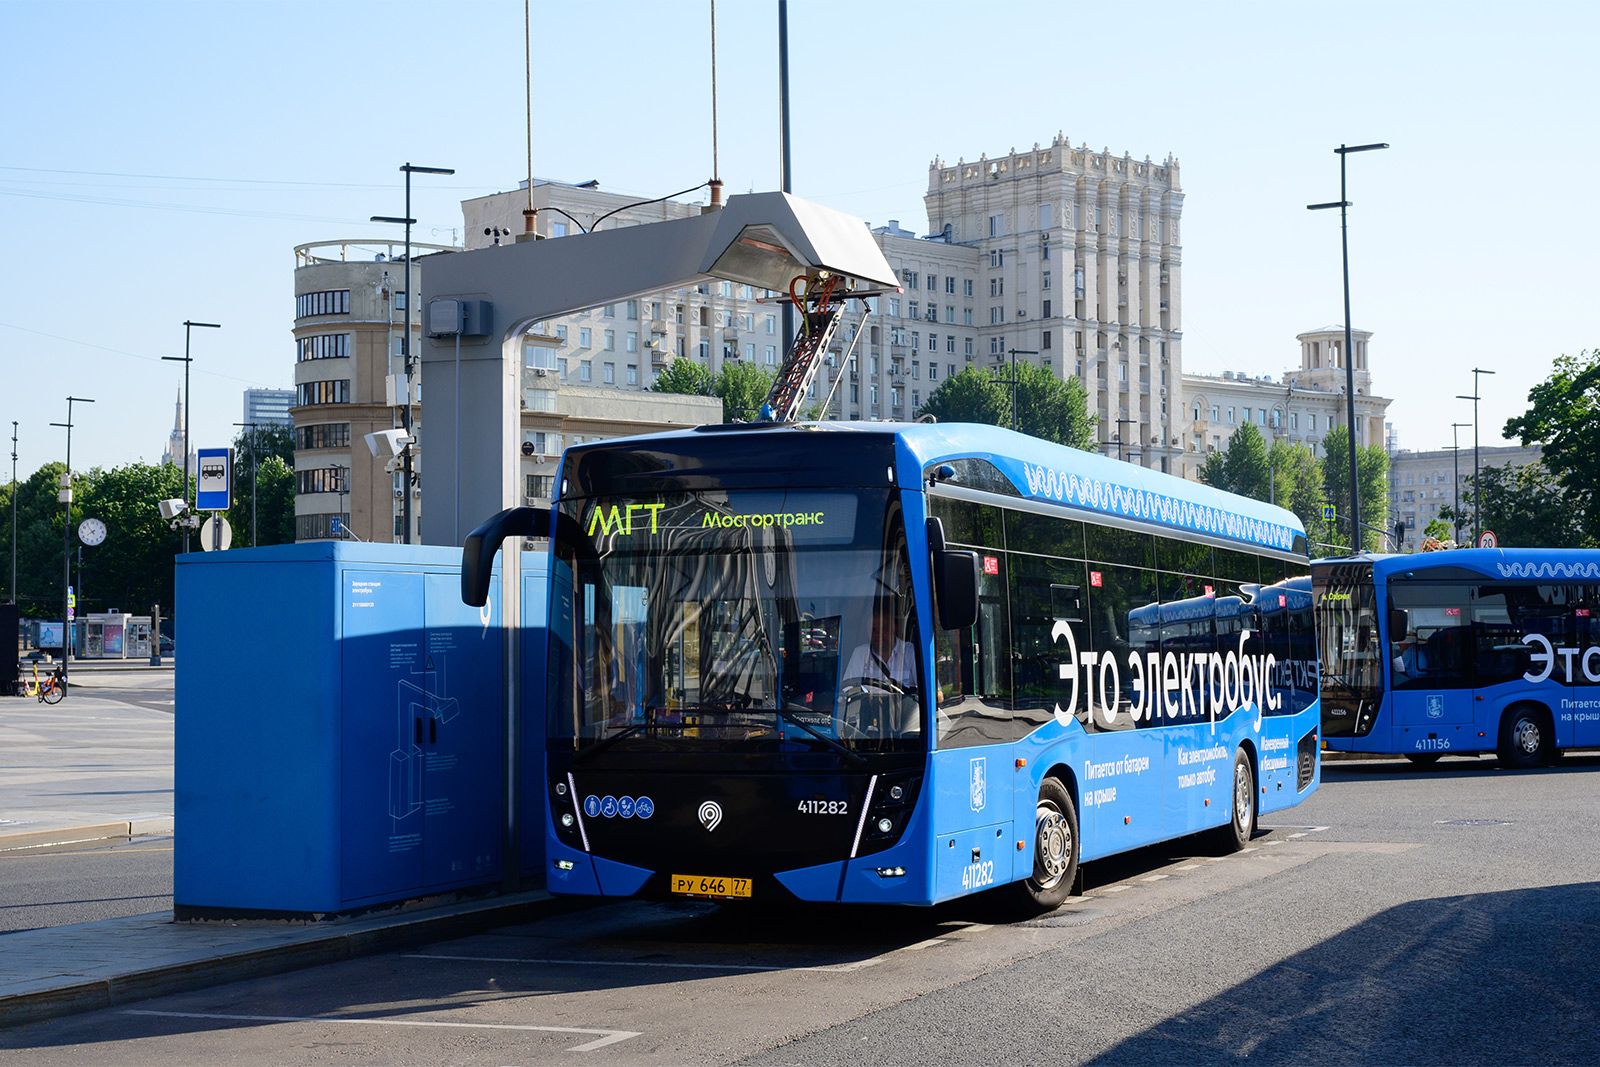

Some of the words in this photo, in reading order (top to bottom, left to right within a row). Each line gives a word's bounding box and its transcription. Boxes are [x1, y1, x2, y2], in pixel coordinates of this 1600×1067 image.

[588, 503, 665, 536] МГТ
[702, 511, 824, 532] Мосгортранс
[1482, 538, 1493, 548] 20
[1521, 633, 1600, 683] Это
[1051, 619, 1120, 727] Это
[1561, 698, 1600, 709] Питаетс
[1561, 713, 1572, 721] на
[1574, 713, 1600, 723] крыш
[1415, 739, 1450, 749] 411156
[1178, 747, 1188, 765] Как
[1084, 760, 1115, 781] Питается
[1116, 760, 1123, 776] от
[1124, 754, 1150, 776] батареи
[1197, 765, 1215, 787] автобус
[797, 800, 848, 815] 411282
[1084, 791, 1093, 807] на
[1094, 787, 1116, 808] крыше
[962, 860, 994, 890] 411282
[699, 878, 726, 894] 646
[733, 879, 747, 891] 77
